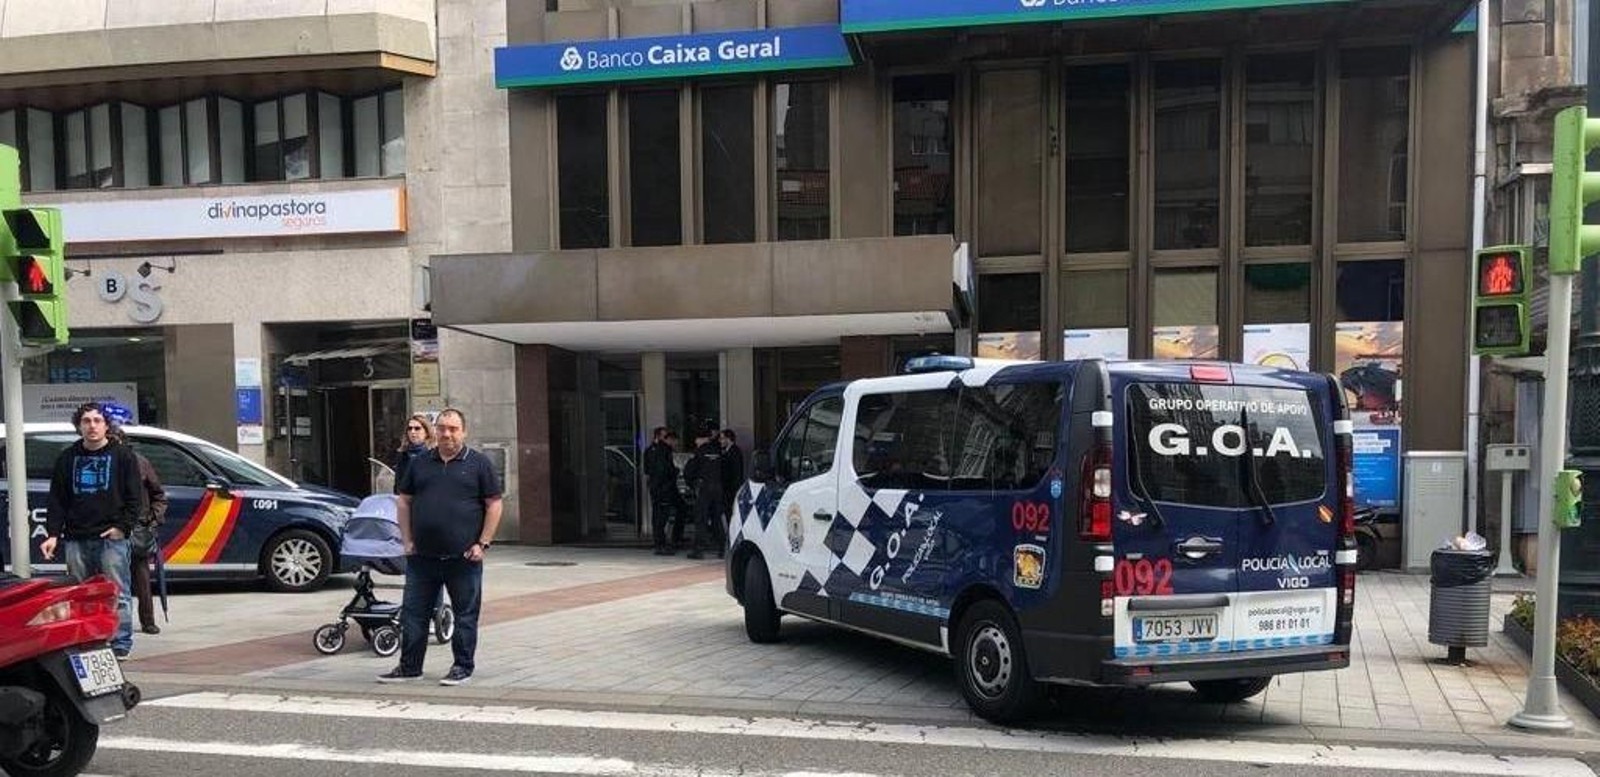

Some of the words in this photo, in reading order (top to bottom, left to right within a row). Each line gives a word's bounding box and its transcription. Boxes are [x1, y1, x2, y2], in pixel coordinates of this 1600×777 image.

[588, 49, 643, 69] Banco
[647, 43, 711, 65] Caixa
[718, 37, 781, 60] Geral
[207, 199, 326, 220] divinapastora
[106, 279, 118, 293] B
[362, 356, 374, 378] 3
[1149, 398, 1193, 411] GRUPO
[1261, 402, 1275, 414] DE
[1148, 423, 1312, 458] G.O.A.
[1011, 501, 1050, 531] 092
[869, 493, 925, 591] G.O.A.
[1298, 555, 1332, 568] LOCAL
[1114, 558, 1175, 596] 092
[1277, 576, 1310, 589] VIGO
[1145, 620, 1183, 637] 7053
[1187, 618, 1214, 636] JVV
